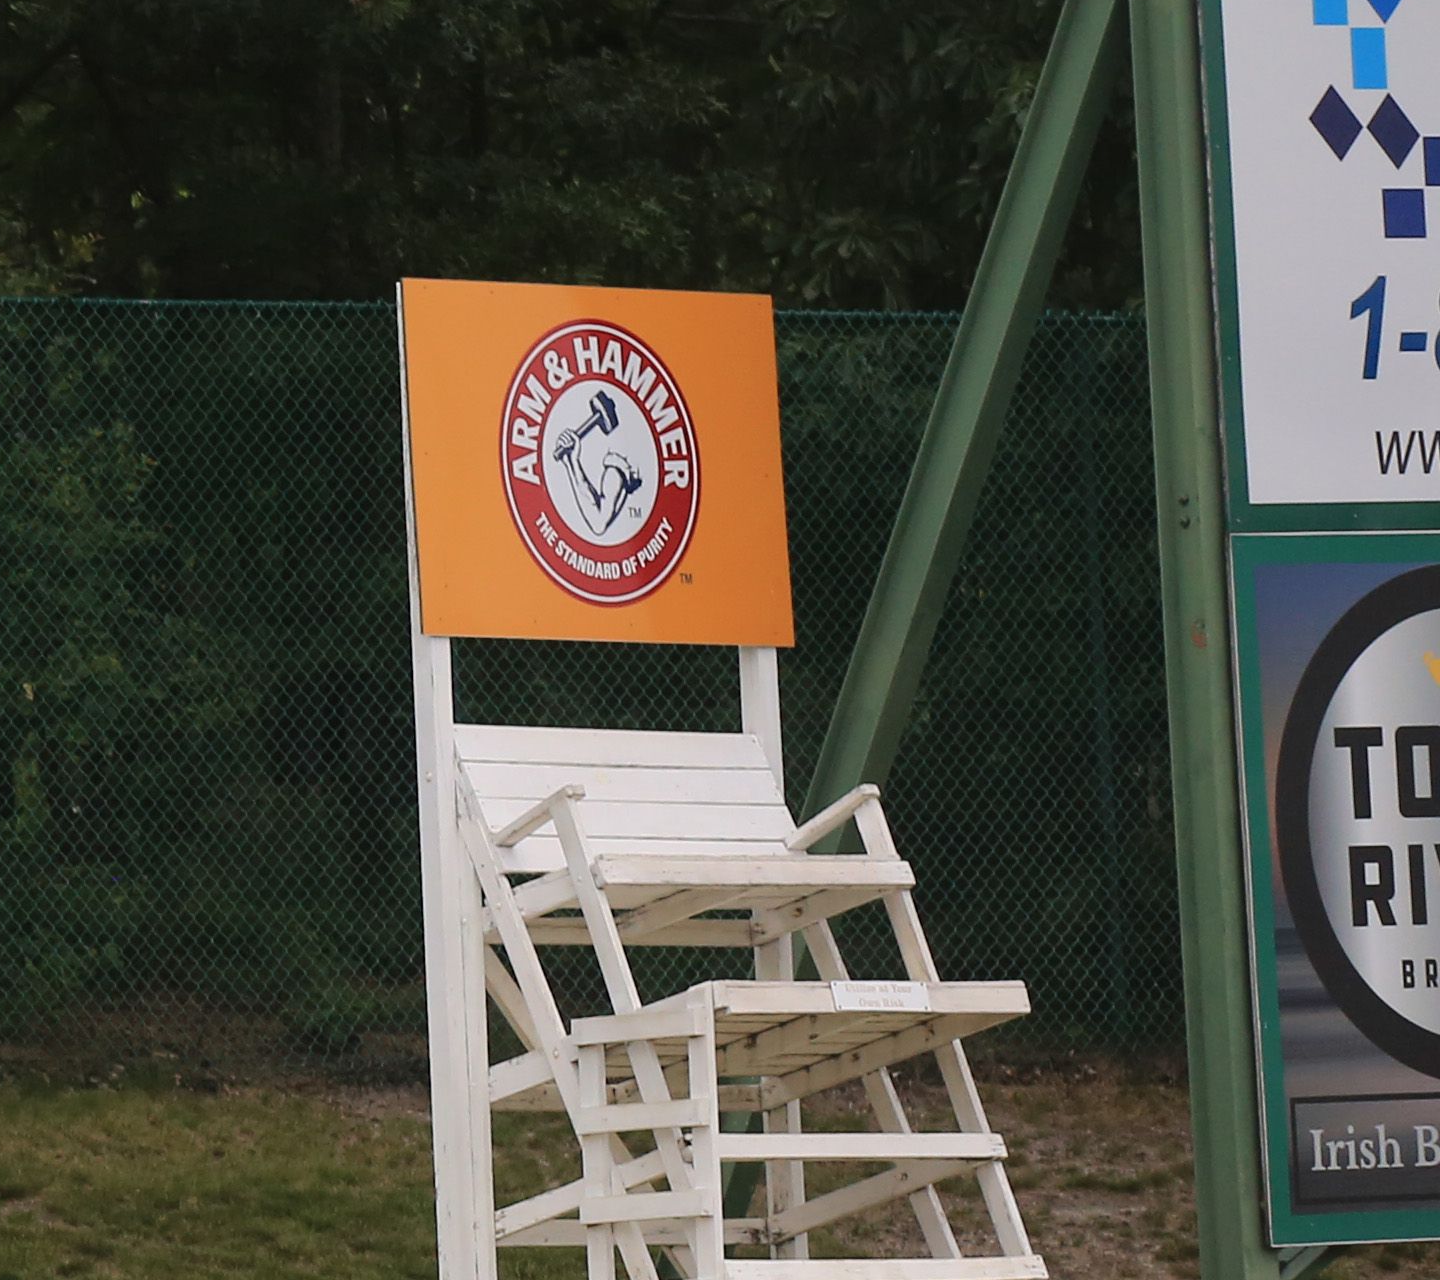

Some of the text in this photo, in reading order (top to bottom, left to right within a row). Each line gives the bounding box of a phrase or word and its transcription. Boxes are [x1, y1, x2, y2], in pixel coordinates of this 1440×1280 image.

[1350, 275, 1440, 381] 1-
[511, 334, 691, 490] ARM & HAMMER
[535, 511, 674, 580] THE STANDARD OF PURITY
[1348, 844, 1440, 928] RI
[1309, 1124, 1404, 1171] Irish
